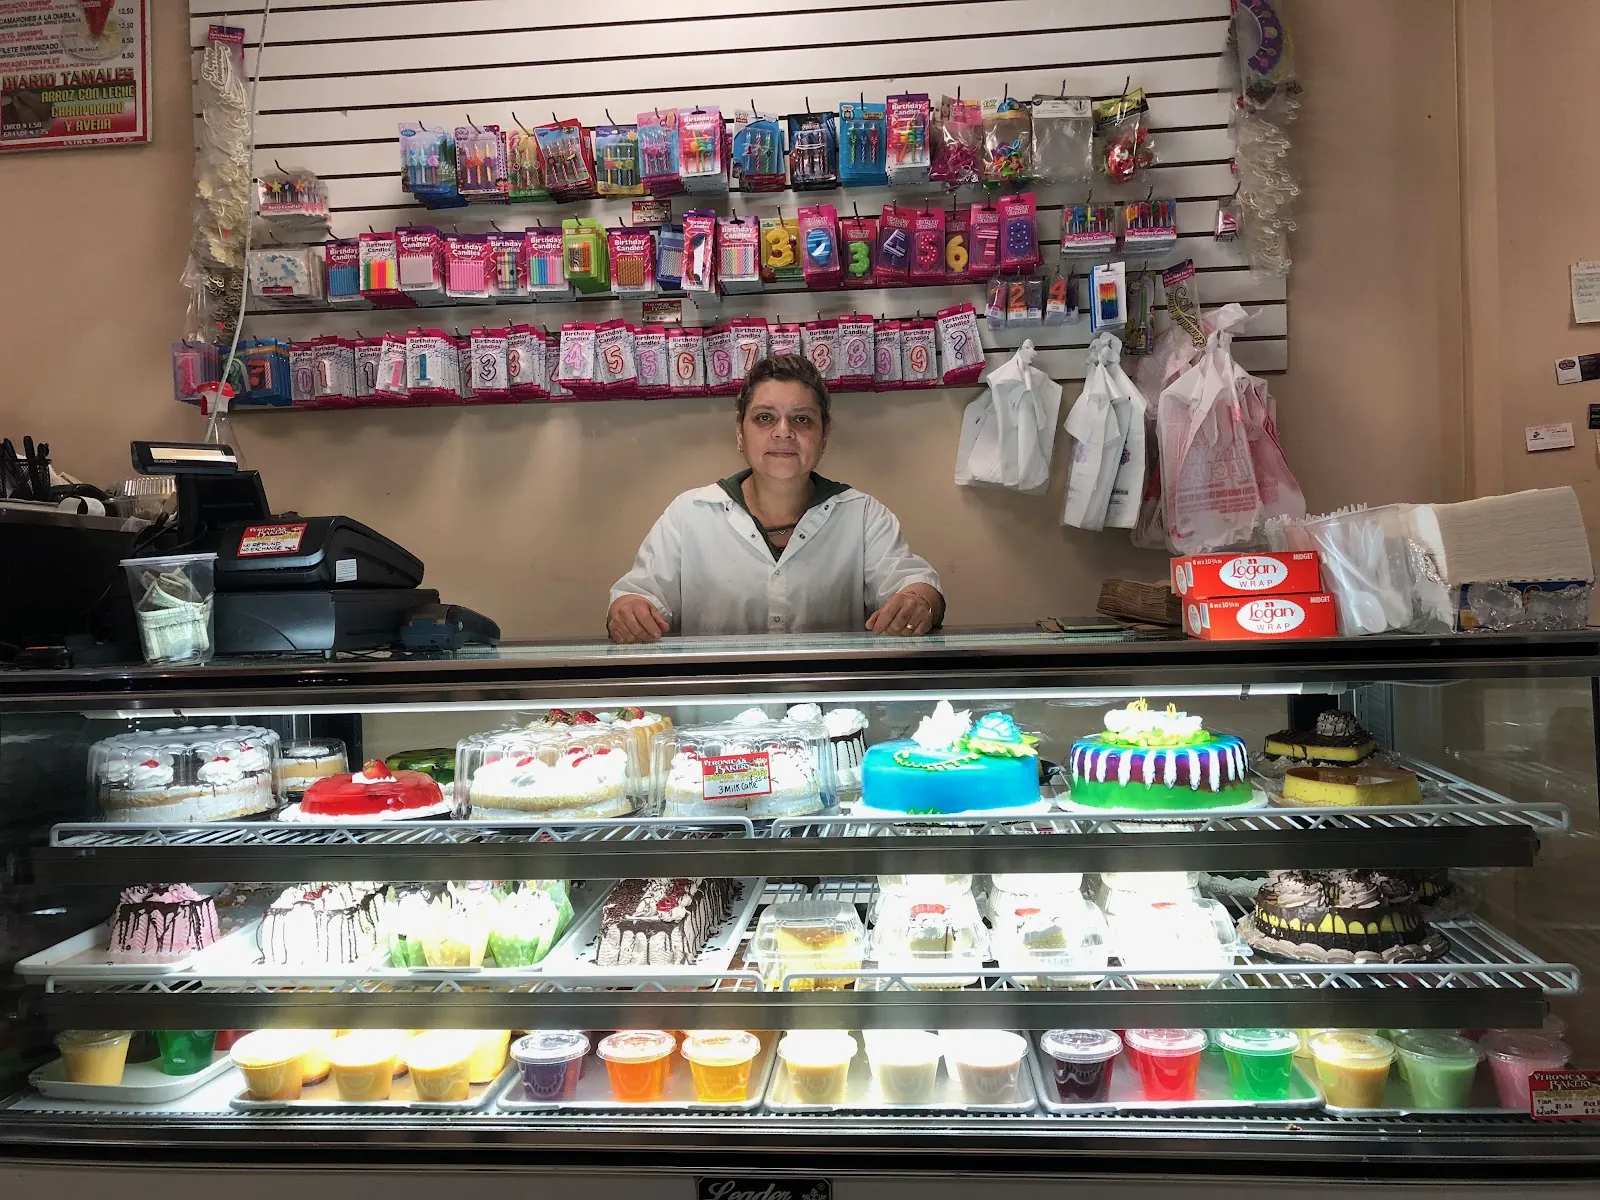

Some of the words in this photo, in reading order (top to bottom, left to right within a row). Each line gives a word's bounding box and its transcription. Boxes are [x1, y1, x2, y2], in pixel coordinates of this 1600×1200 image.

[20, 42, 59, 51] EMPANIZADO
[2, 72, 56, 89] DIARIO
[61, 67, 134, 85] TAMALES
[42, 90, 75, 103] ARROZ
[78, 87, 99, 101] CON
[102, 85, 134, 99] LECHE
[892, 102, 923, 110] Birthday
[64, 121, 73, 132] Y
[76, 119, 111, 132] AVENA
[450, 242, 483, 251] Birthday
[530, 236, 562, 244] Birthday
[766, 228, 794, 268] 3
[916, 231, 939, 264] 5
[452, 248, 481, 256] Candles
[848, 241, 870, 276] 3
[946, 235, 969, 272] 6
[1009, 285, 1025, 308] 2
[1049, 279, 1066, 301] 4
[943, 314, 971, 324] Birthday
[944, 319, 970, 329] Candles
[596, 329, 623, 338] Birthday
[598, 335, 623, 344] Candles
[809, 329, 836, 337] Birthday
[874, 331, 896, 339] irthday
[508, 349, 520, 377] 3
[564, 343, 587, 370] 4
[604, 344, 624, 374] 5
[641, 350, 657, 378] 5
[713, 349, 732, 377] 6
[740, 342, 759, 372] 7
[846, 338, 868, 369] 8
[910, 345, 929, 373] 9
[317, 360, 328, 388] 1
[364, 361, 374, 388] 1
[386, 359, 404, 389] 1
[414, 353, 431, 382] 1
[480, 353, 497, 381] 3
[677, 352, 695, 380] 6
[1293, 553, 1313, 561] MIDGET
[1230, 559, 1279, 580] Logan
[1239, 580, 1273, 588] WRAP
[1247, 603, 1296, 625] Logan
[1256, 623, 1290, 631] WRAP
[703, 757, 748, 766] VERONICA'S
[715, 763, 750, 775] BAKERY
[718, 786, 724, 795] 3
[741, 781, 758, 791] Cake
[1549, 1080, 1592, 1092] BAKERY
[704, 1180, 792, 1200] Leader
